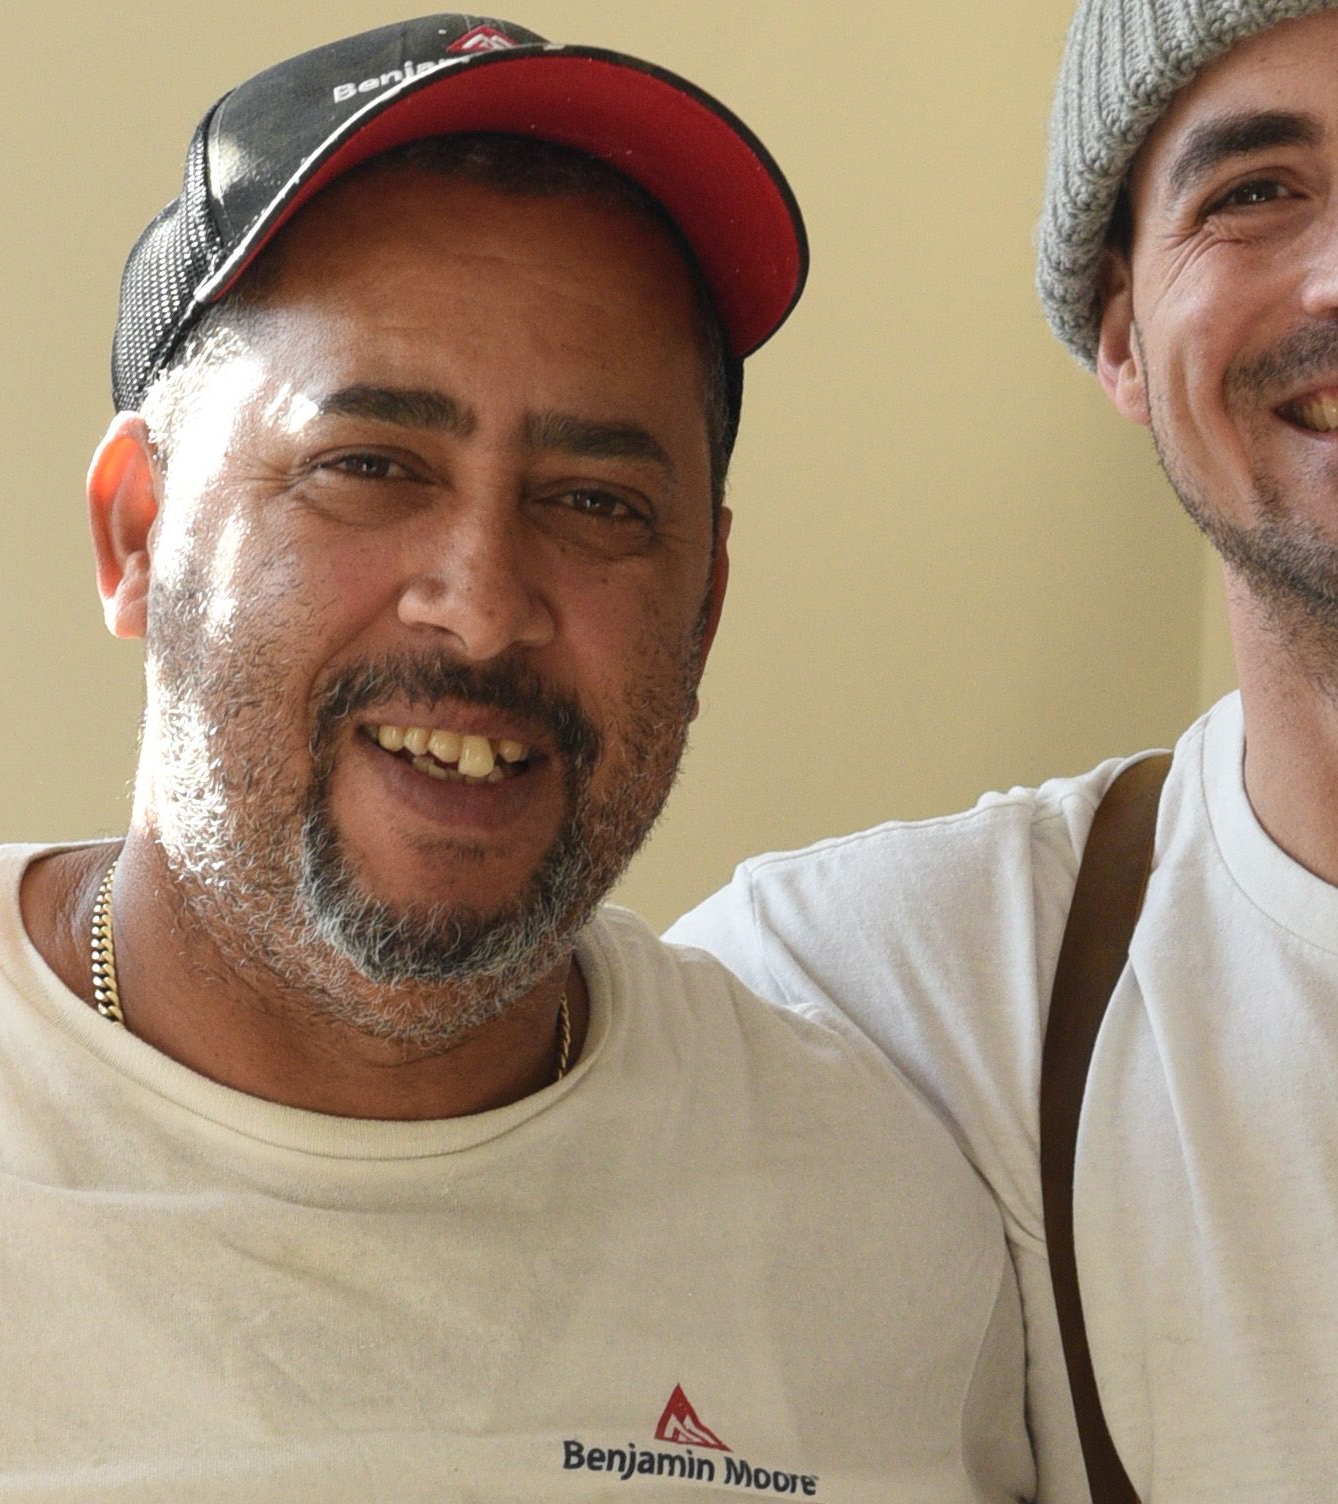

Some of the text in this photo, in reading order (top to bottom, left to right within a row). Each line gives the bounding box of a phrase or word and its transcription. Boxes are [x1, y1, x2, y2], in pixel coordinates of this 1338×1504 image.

[333, 58, 456, 104] Benja
[563, 1440, 818, 1496] Benjamin Moore
